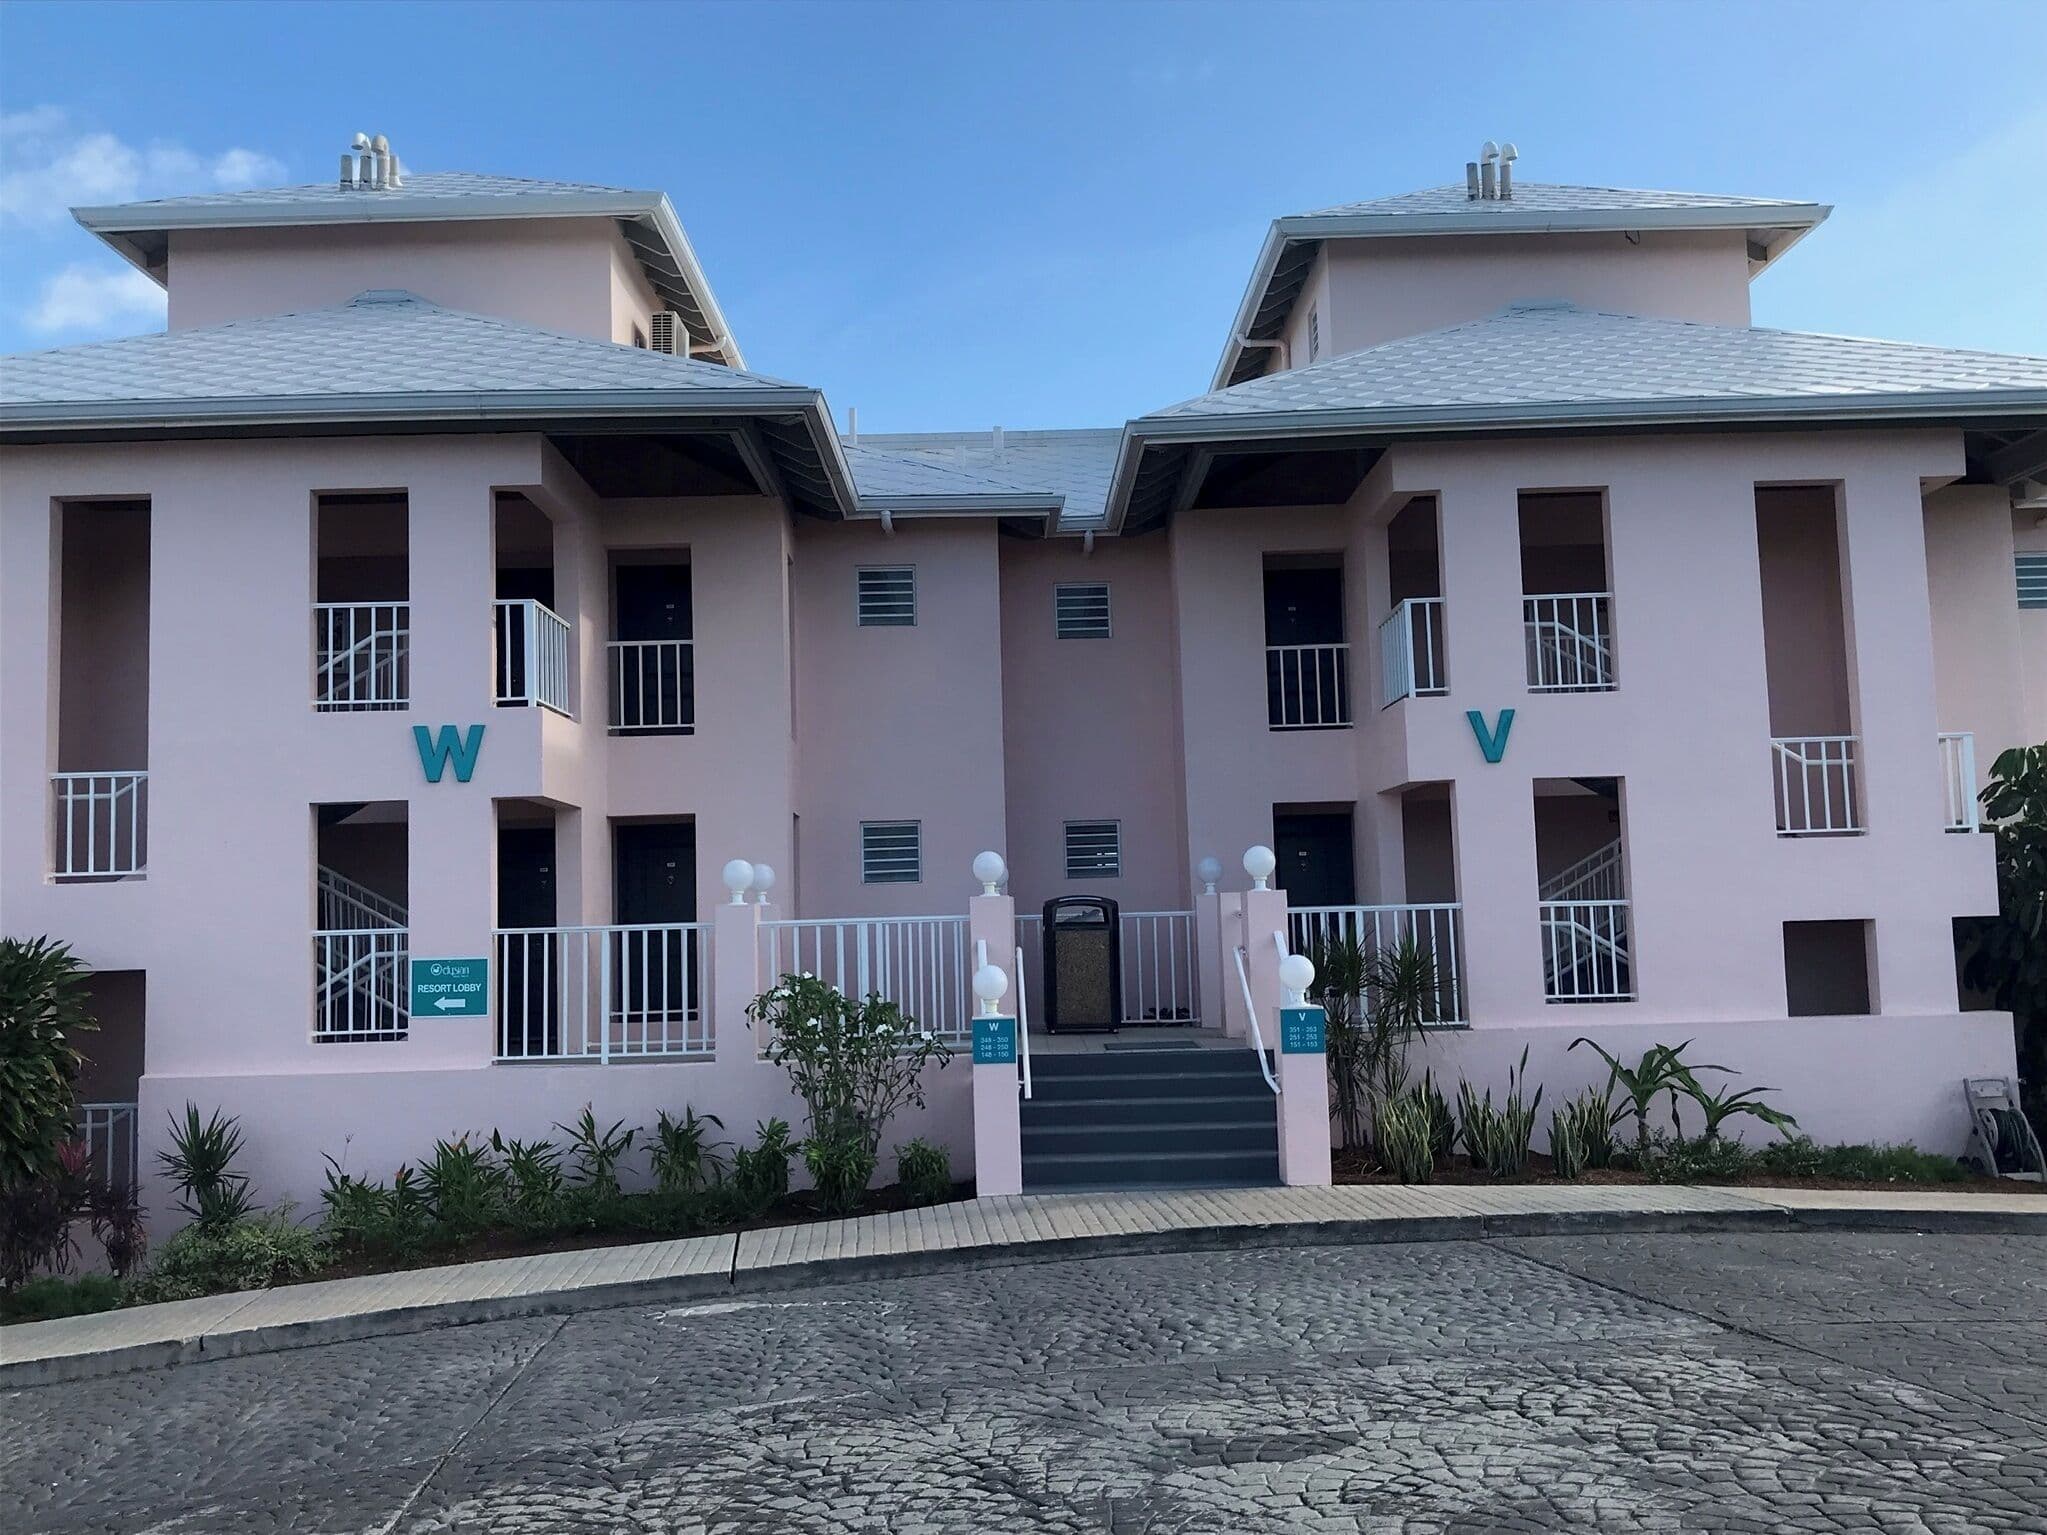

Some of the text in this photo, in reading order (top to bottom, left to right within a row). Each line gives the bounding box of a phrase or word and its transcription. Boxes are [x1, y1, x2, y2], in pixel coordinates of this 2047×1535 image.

[1466, 708, 1515, 763] V
[412, 724, 486, 783] W
[417, 983, 482, 993] RESORT LOBBY
[1298, 1012, 1306, 1021] V
[988, 1022, 999, 1031] W
